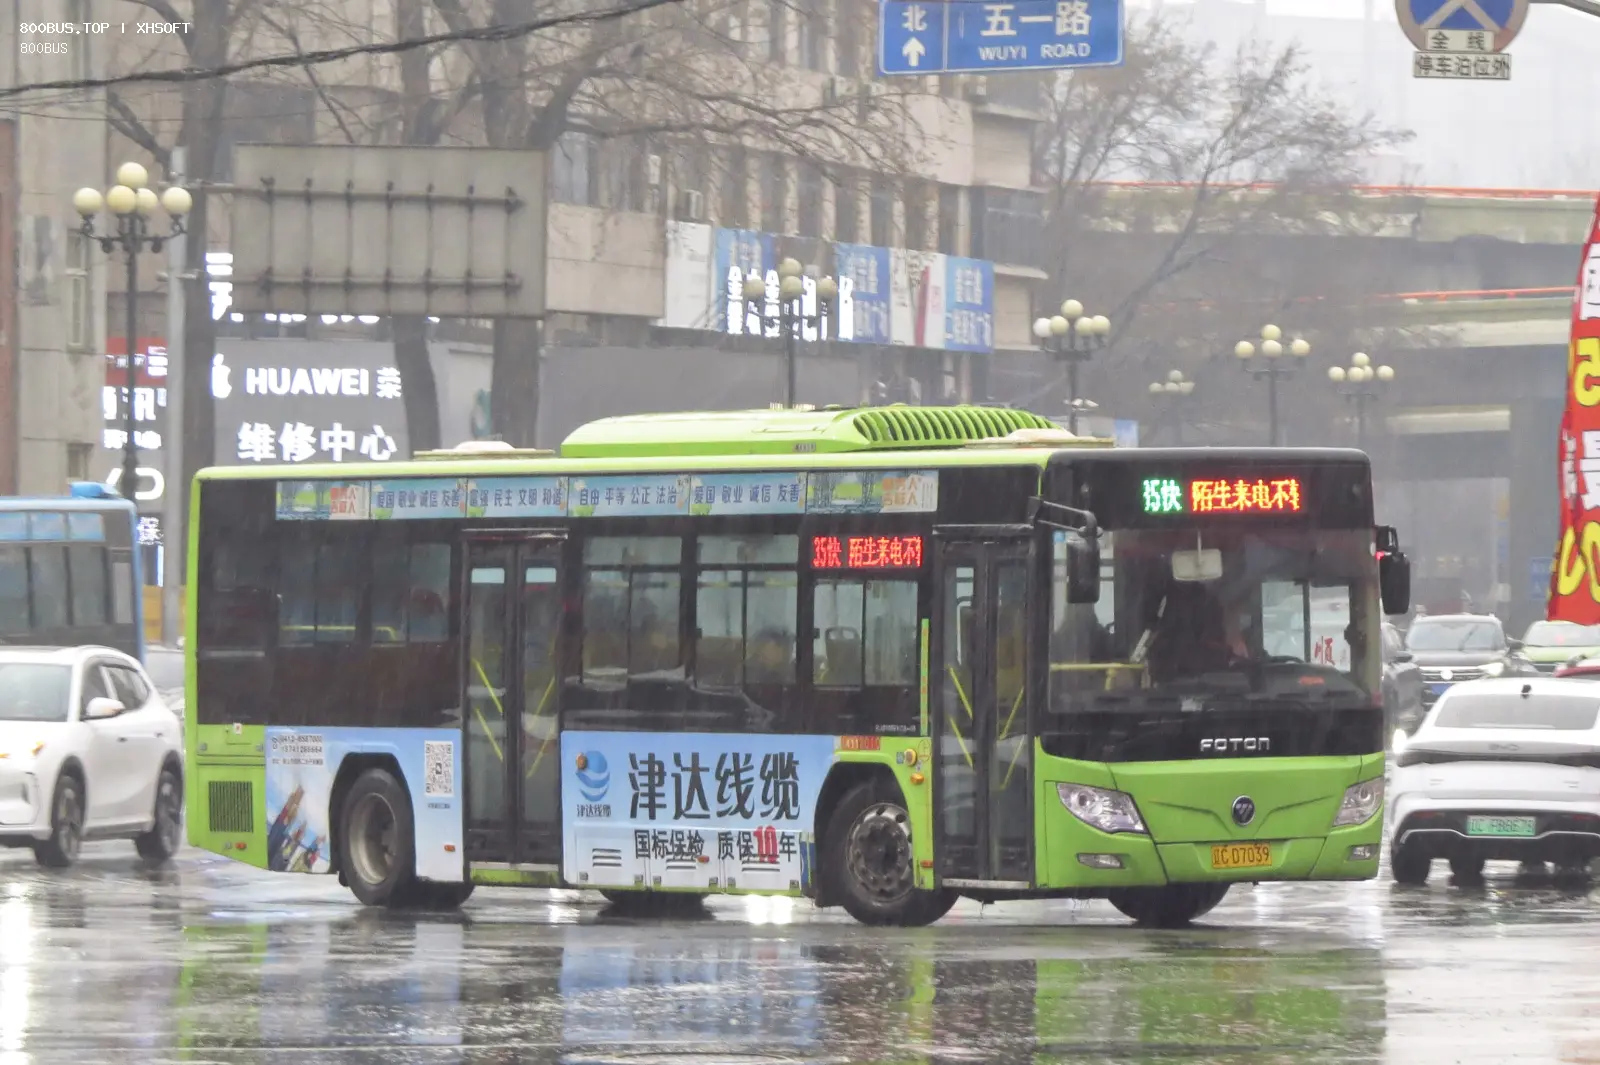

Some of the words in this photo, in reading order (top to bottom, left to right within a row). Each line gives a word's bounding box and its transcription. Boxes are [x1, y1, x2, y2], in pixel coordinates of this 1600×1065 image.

[902, 5, 927, 32] 北
[980, 1, 1091, 36] 五一路
[979, 46, 1027, 60] WUYI
[1041, 43, 1091, 58] ROAD
[246, 367, 369, 395] HUAWEI
[237, 421, 398, 462] 维修中心
[494, 488, 512, 506] 民主
[518, 488, 537, 506] 文明
[580, 488, 599, 505] 自由
[605, 487, 625, 505] 平等
[631, 486, 651, 504] 公正
[656, 485, 677, 504] 法治
[694, 486, 715, 504] 爱国
[722, 485, 743, 503] 敬业
[750, 484, 772, 502] 诚信
[778, 484, 800, 502] 友善
[813, 536, 842, 567] 35快
[1200, 737, 1270, 751] FOTON
[629, 752, 800, 820] 津达线缆
[576, 804, 612, 818] 津达线缆
[634, 830, 705, 859] 国标保检
[717, 825, 797, 863] 质保10年
